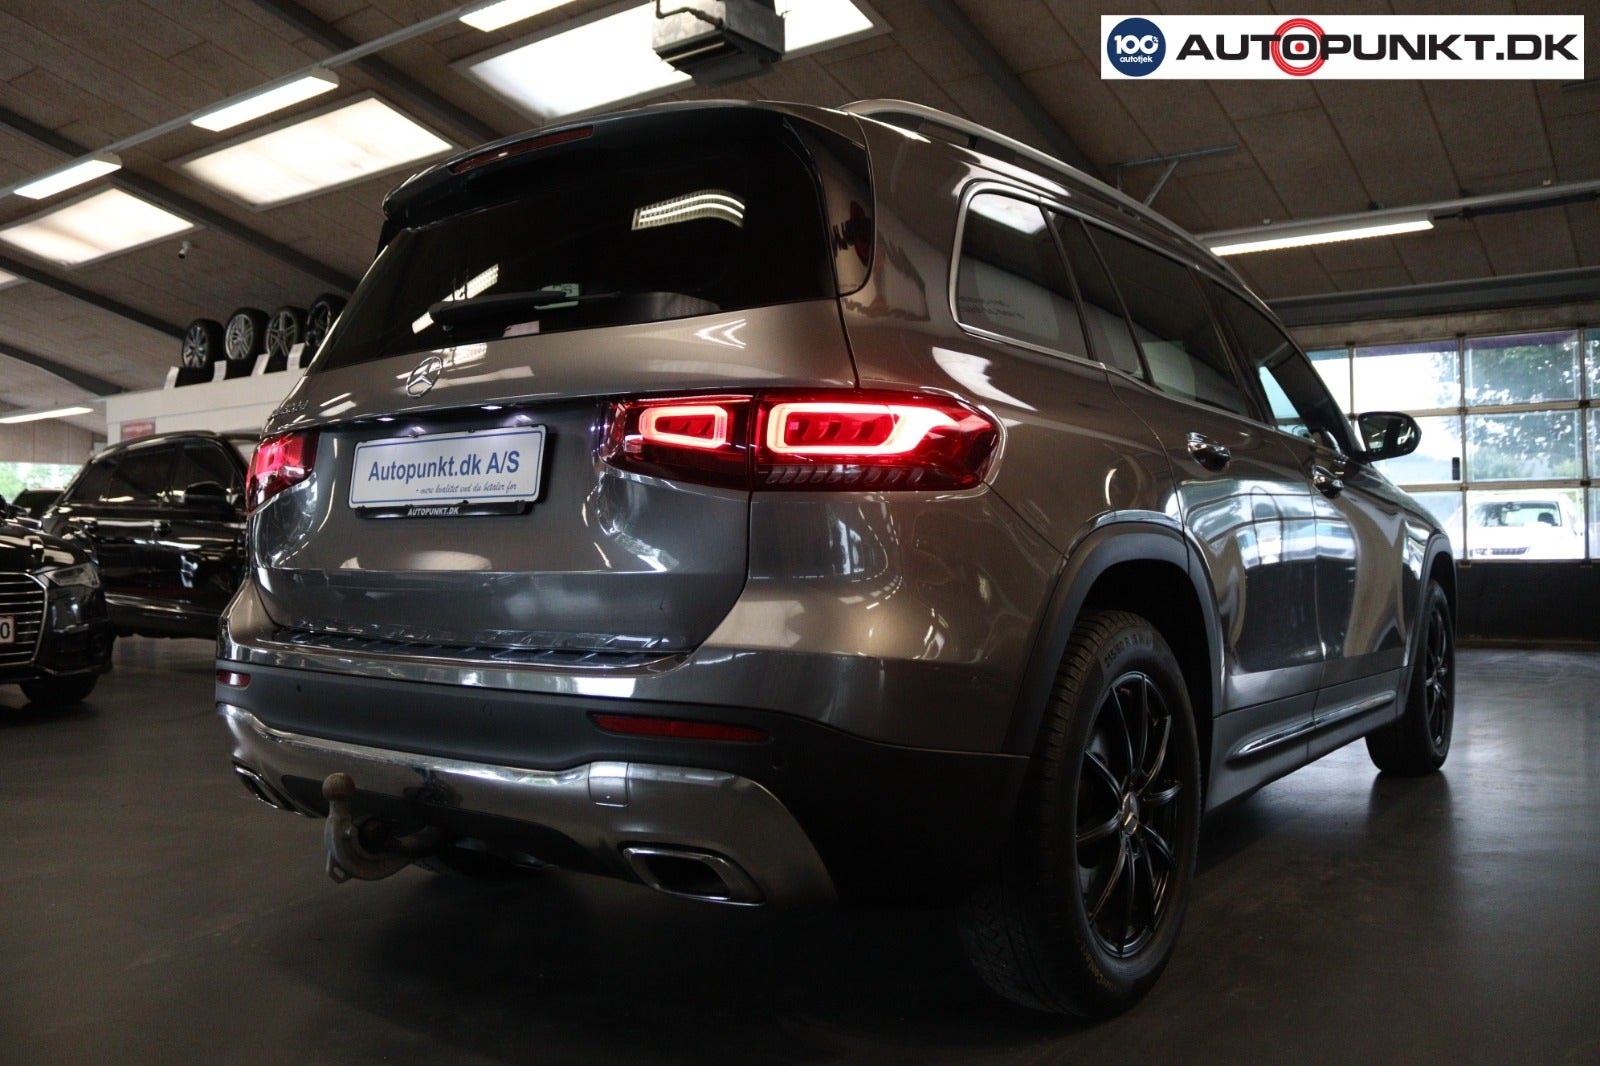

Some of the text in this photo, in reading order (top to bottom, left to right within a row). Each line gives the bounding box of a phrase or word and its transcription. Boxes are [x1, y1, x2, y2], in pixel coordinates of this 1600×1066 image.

[368, 450, 520, 484] Autopunkt.dk A/S
[407, 506, 459, 516] AUTOPUNKT.DK
